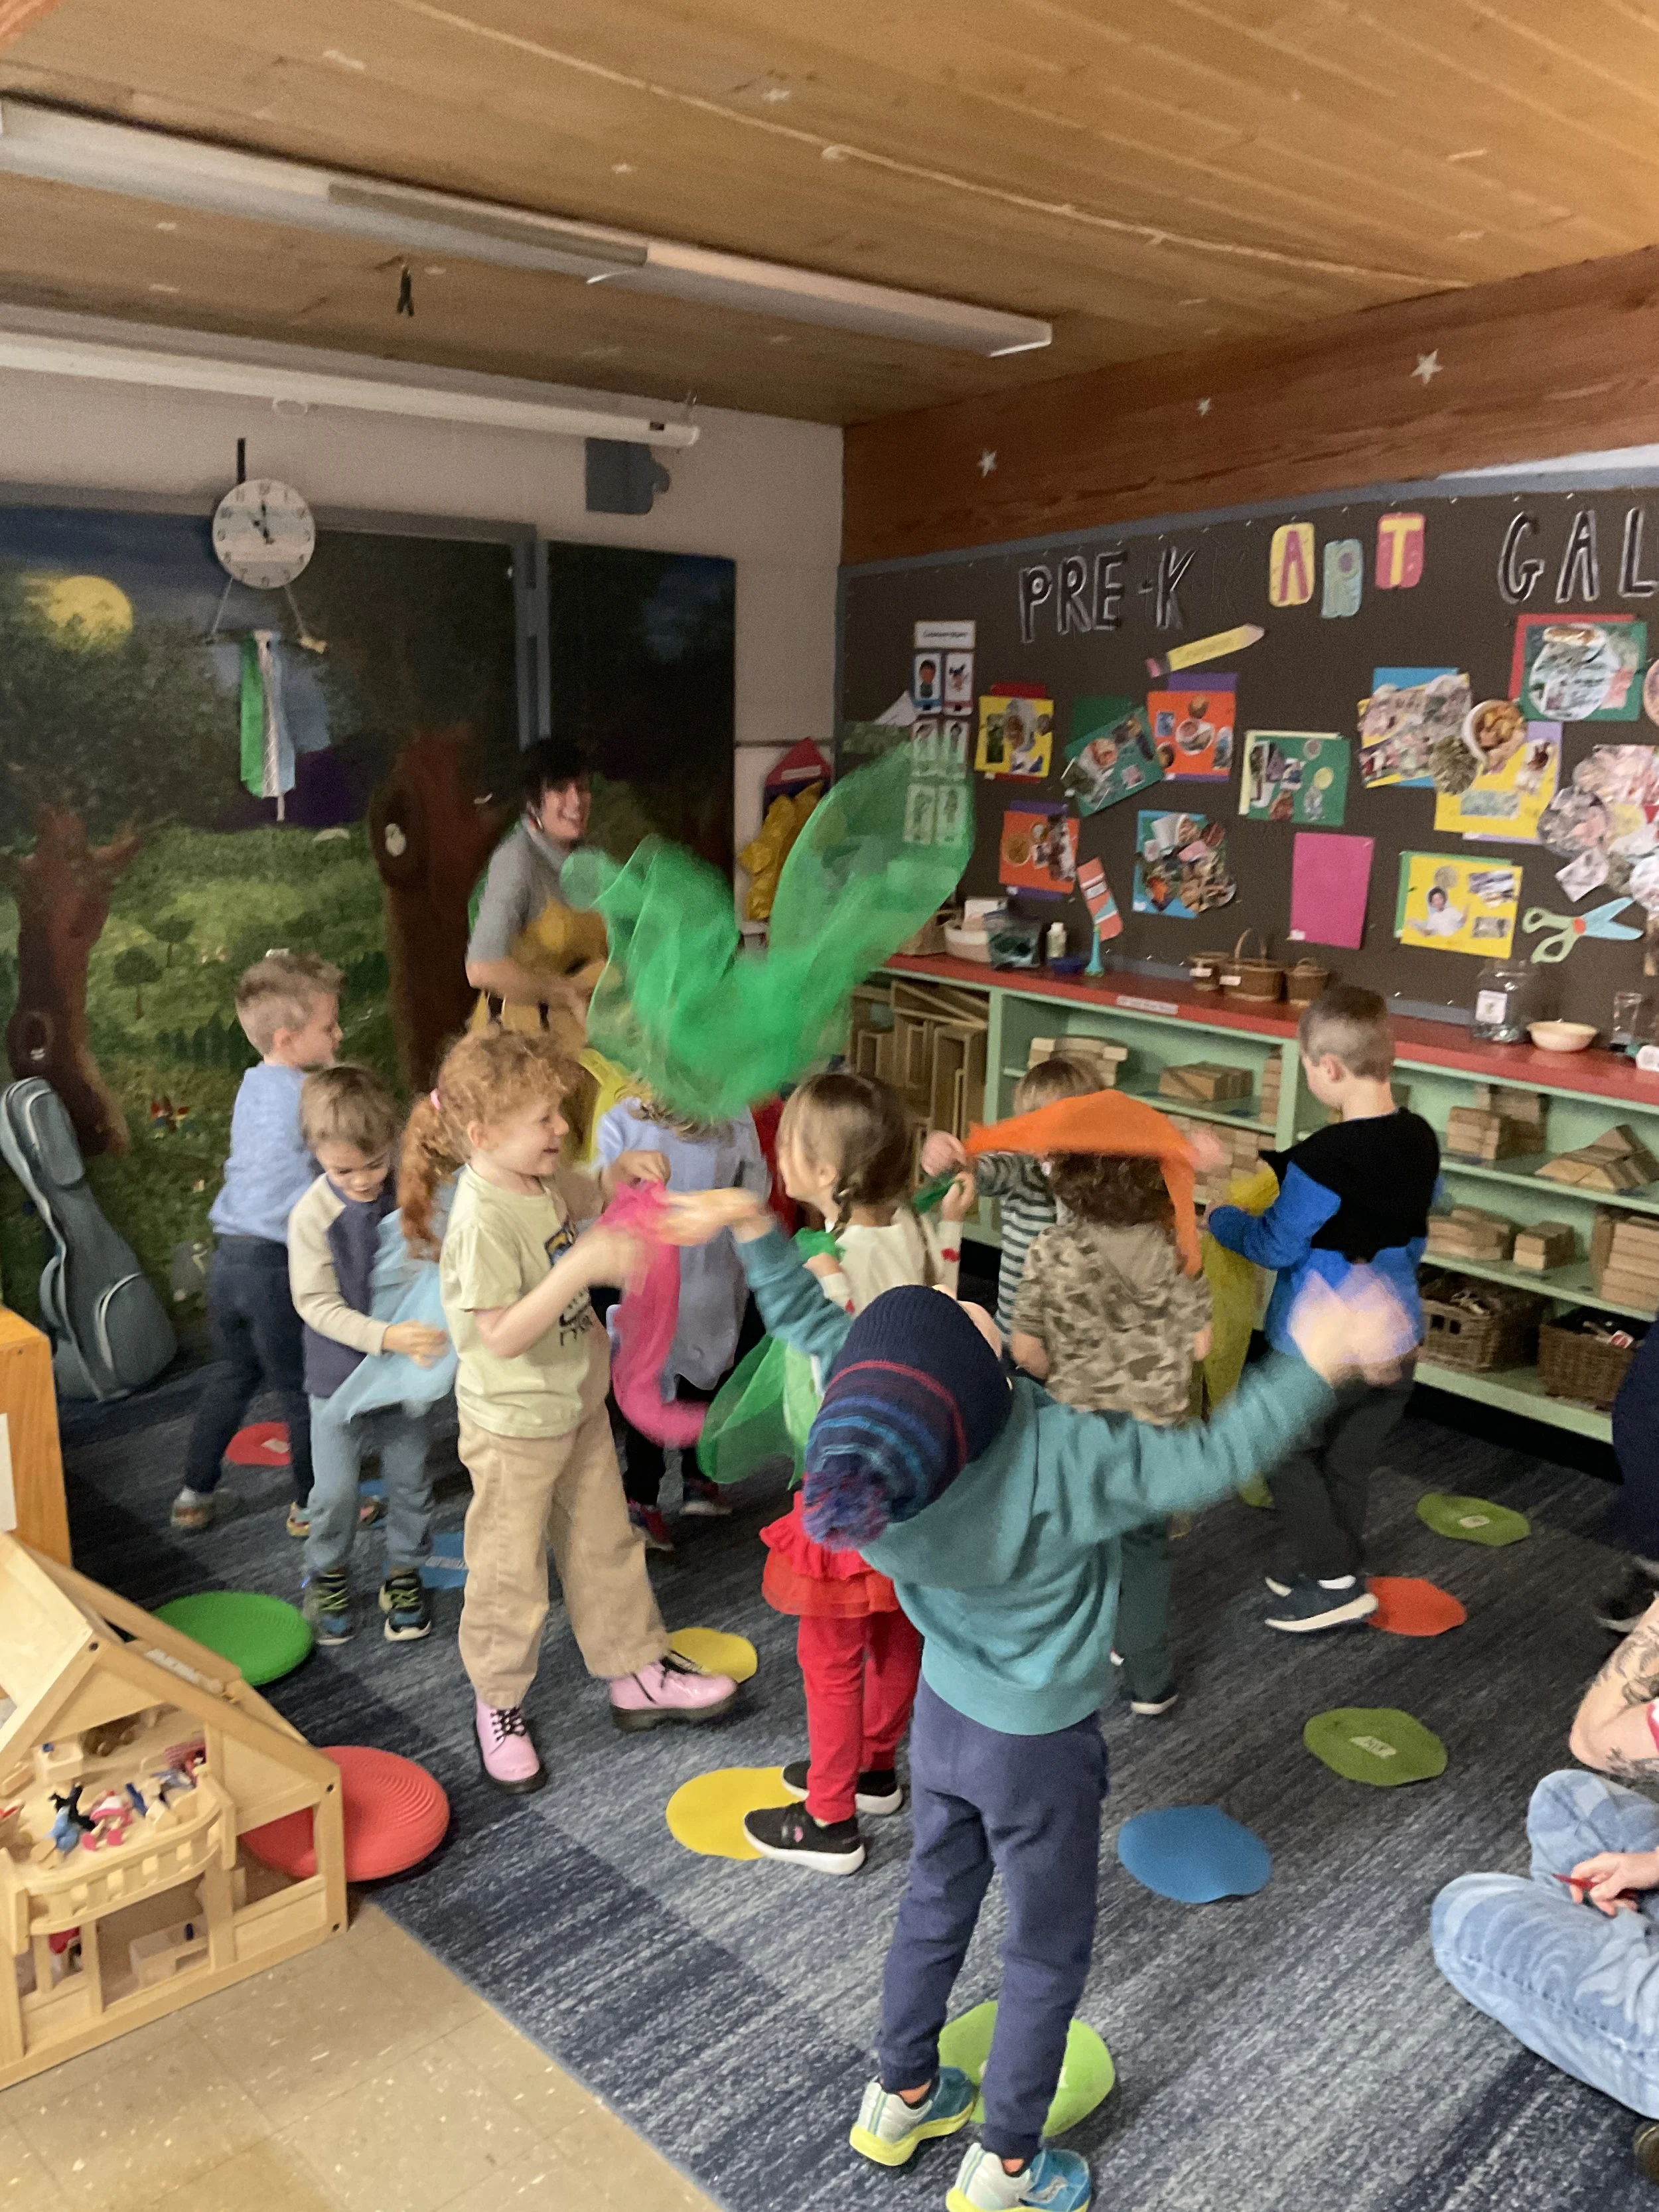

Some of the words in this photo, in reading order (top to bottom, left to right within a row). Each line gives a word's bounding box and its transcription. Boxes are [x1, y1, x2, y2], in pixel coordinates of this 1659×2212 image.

[1019, 546, 1196, 643] PRE-K
[1274, 515, 1423, 616] ART
[1498, 507, 1659, 605] GAL
